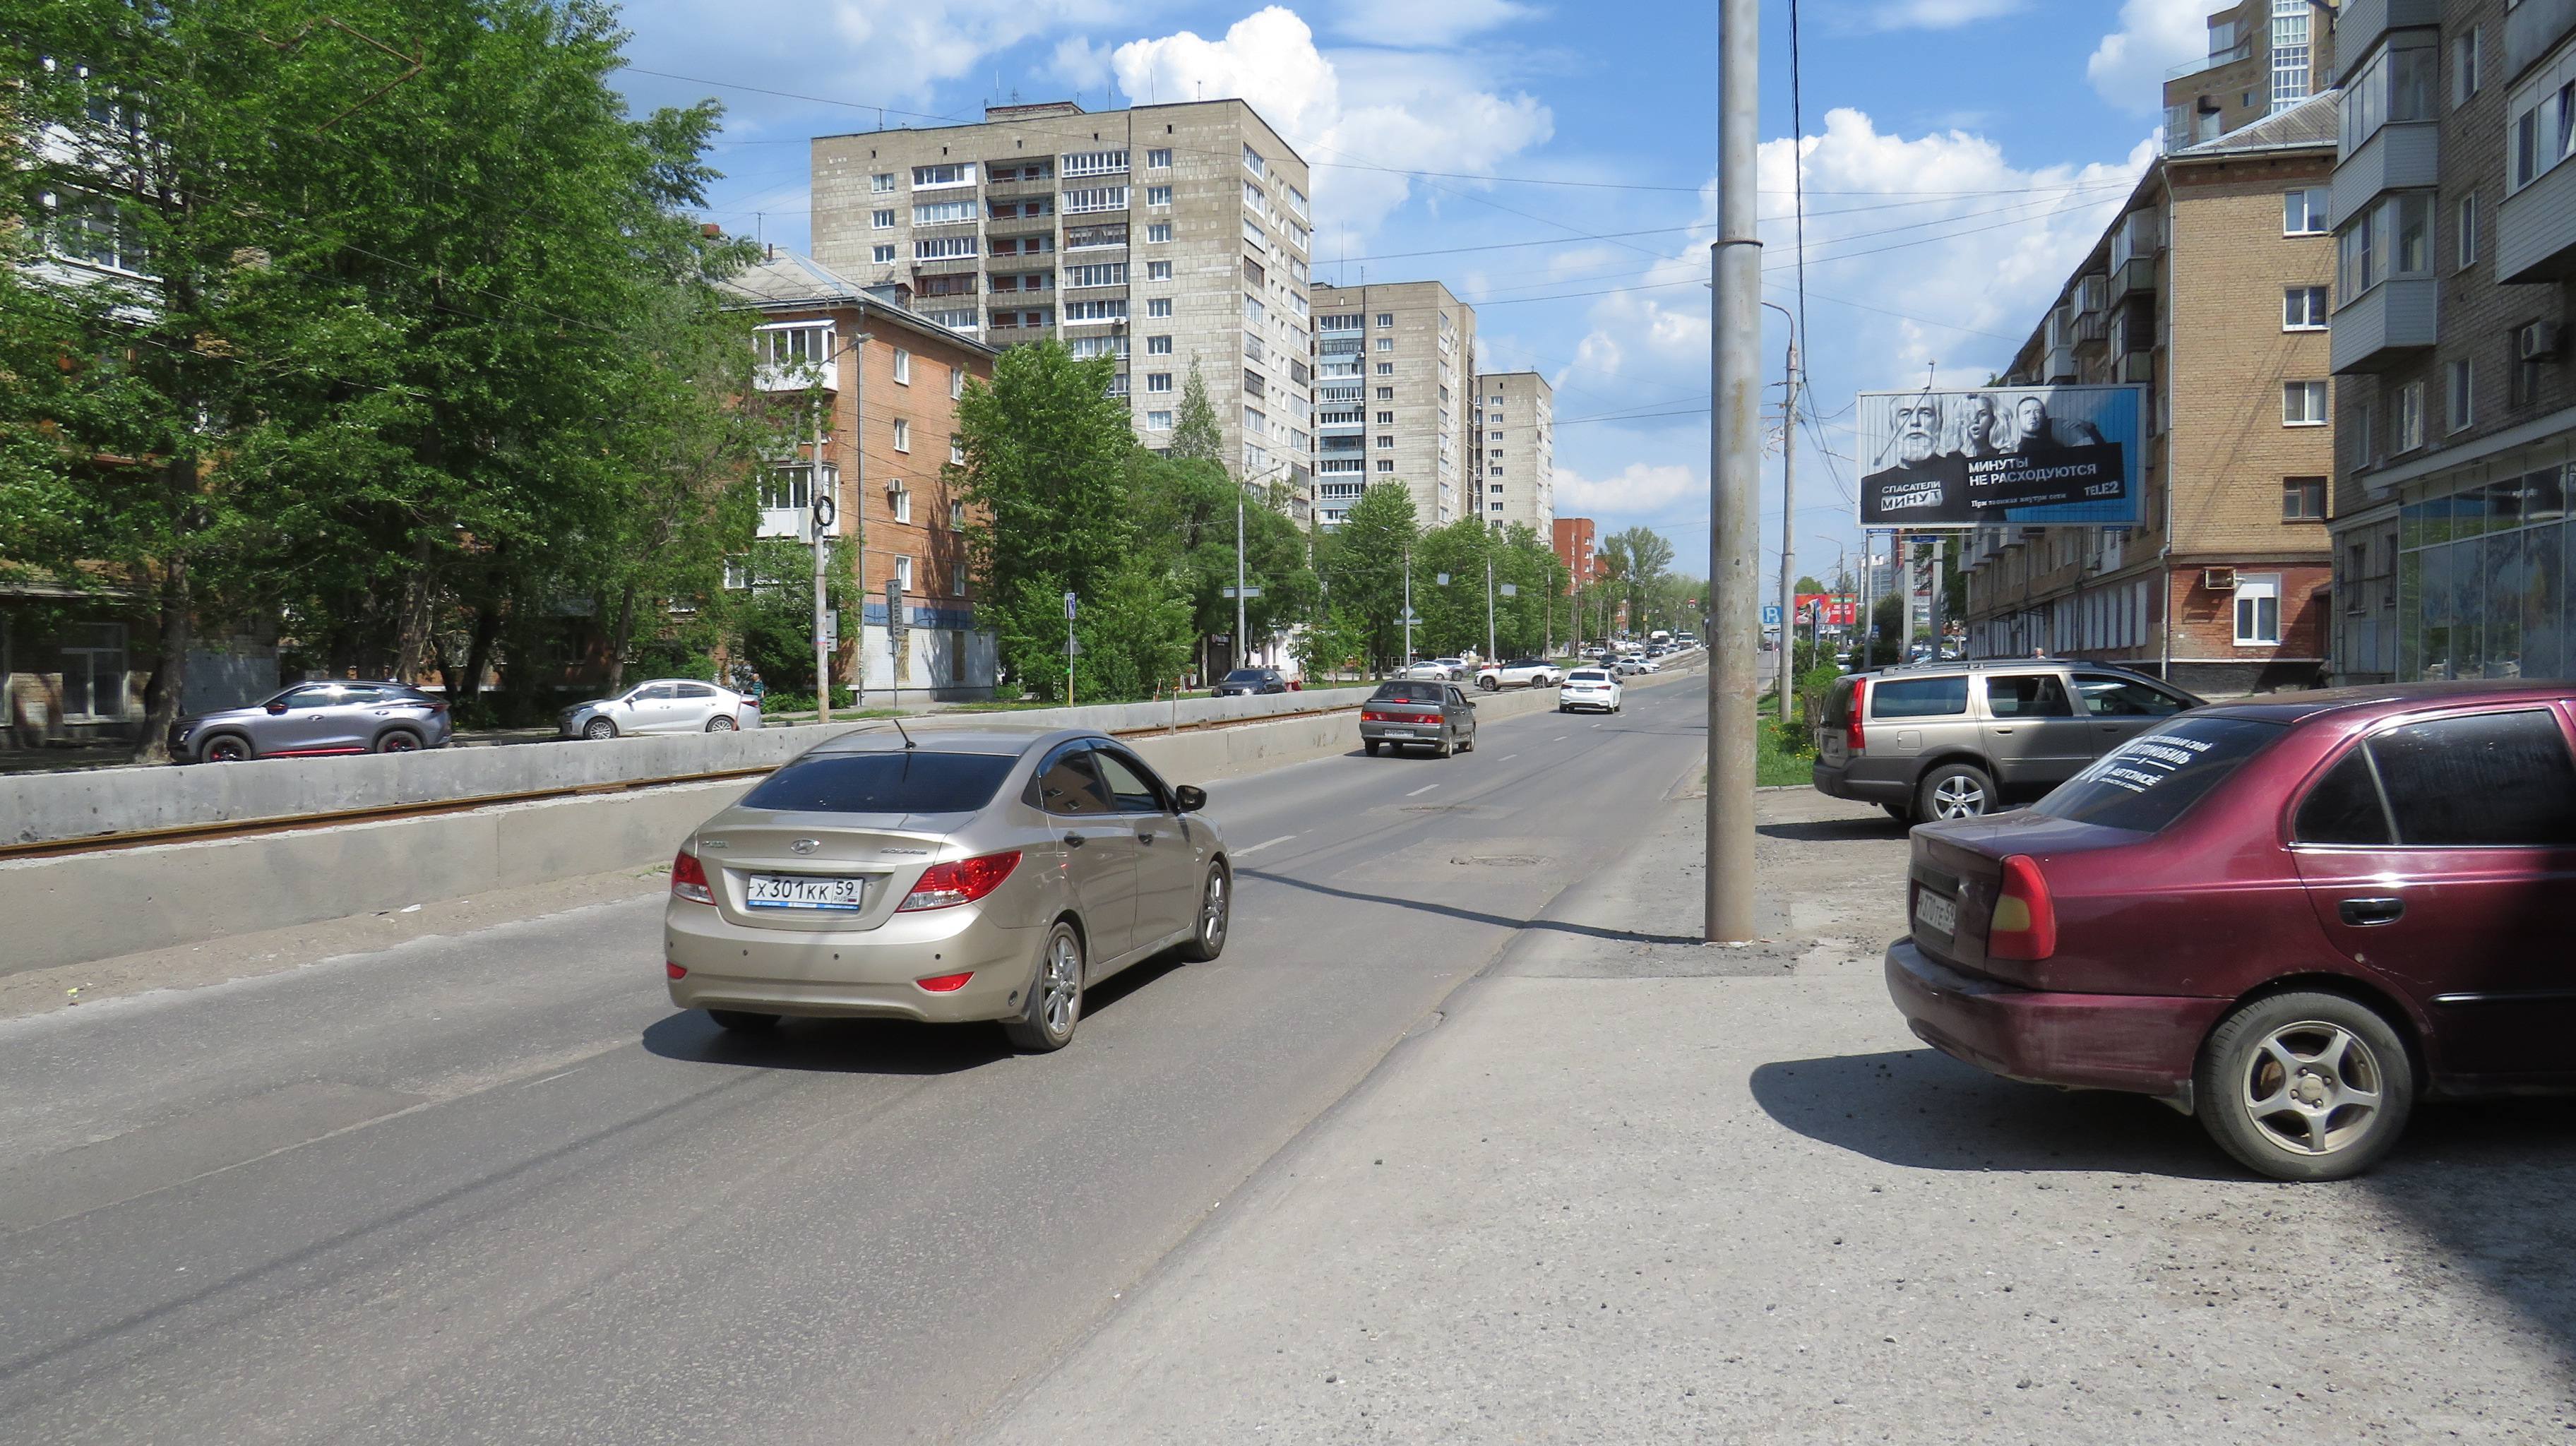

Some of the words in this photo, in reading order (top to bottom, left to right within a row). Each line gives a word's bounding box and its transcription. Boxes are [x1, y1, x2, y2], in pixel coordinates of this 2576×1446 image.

[1968, 458, 2028, 474] МИНУТЫ
[1969, 474, 1988, 486] НЕ
[1991, 463, 2097, 485] РАСХОДУЮТСЯ
[1881, 480, 1940, 494] СПАСАТЕЛИ
[2084, 481, 2120, 496] TELE2
[1882, 490, 1940, 510] МИНУТ
[2125, 743, 2193, 765] АВТОМОБИЛЬ
[2184, 739, 2213, 753] СВОЙ
[2108, 767, 2164, 787] АВТОМОЁ
[835, 880, 854, 896] 59
